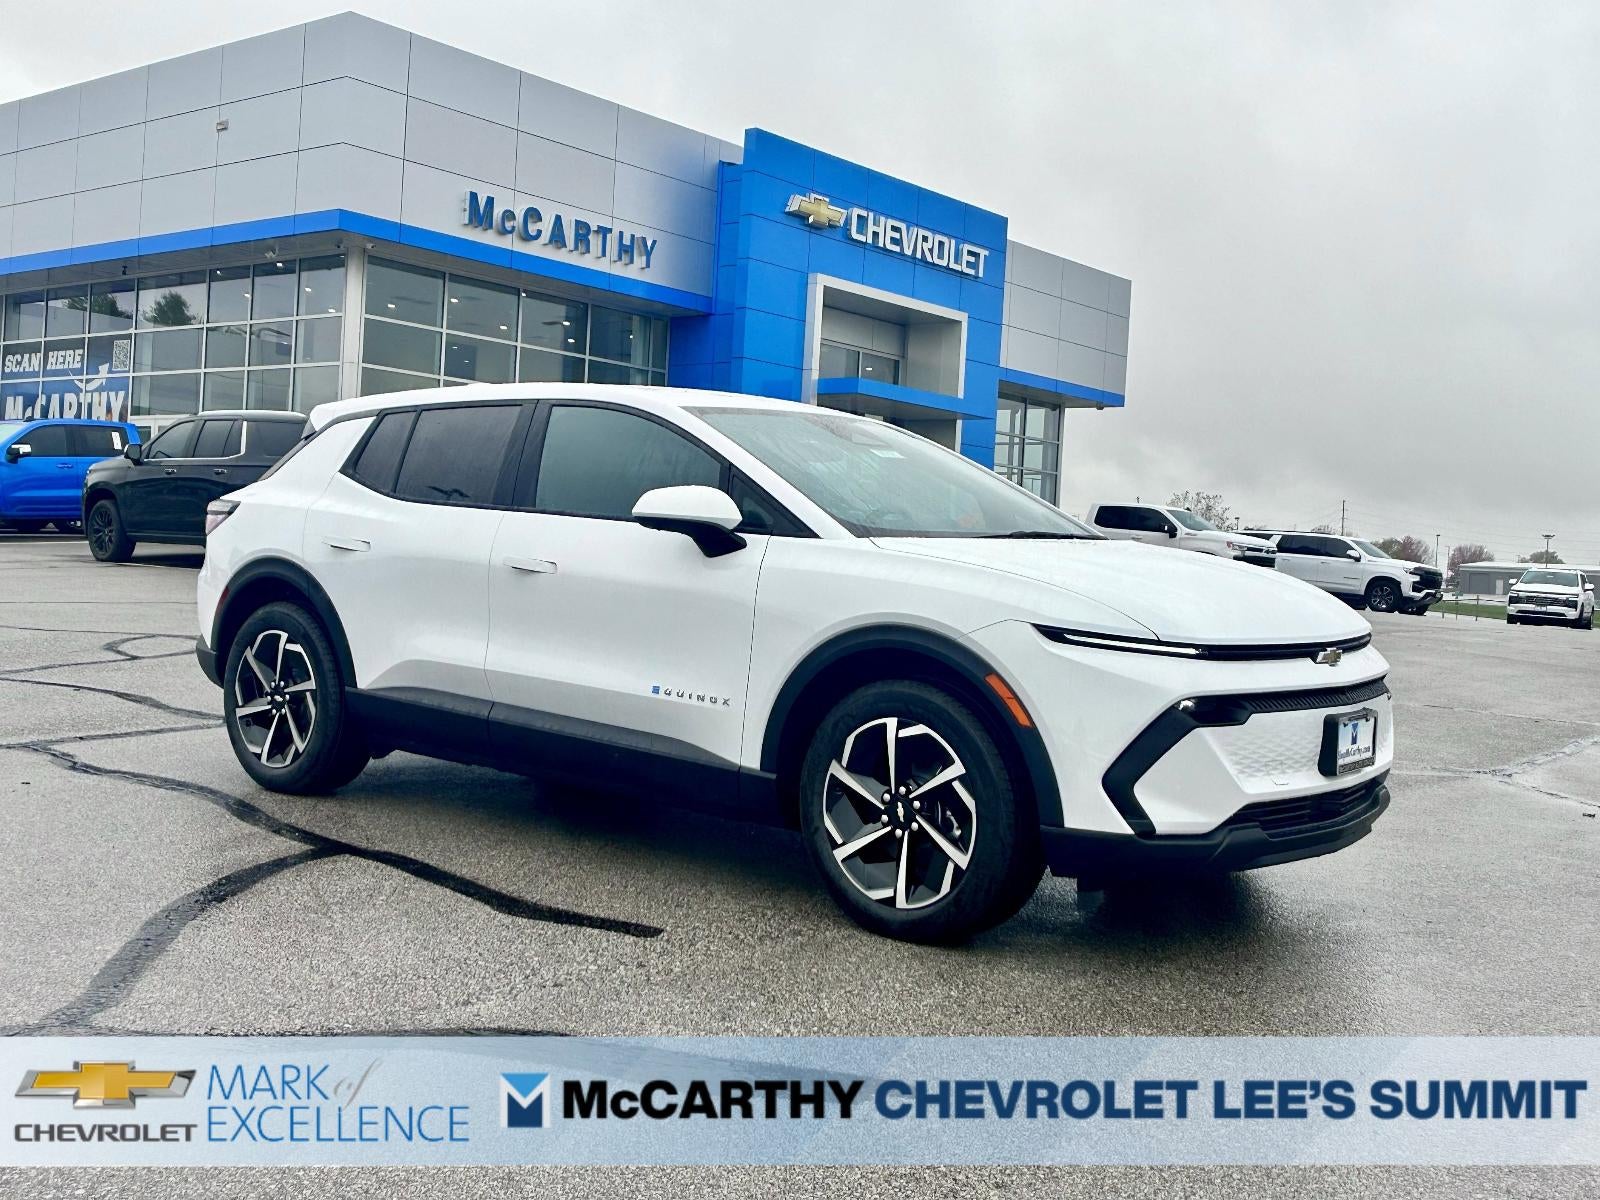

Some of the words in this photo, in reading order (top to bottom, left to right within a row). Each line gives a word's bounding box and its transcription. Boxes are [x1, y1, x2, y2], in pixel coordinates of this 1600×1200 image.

[464, 190, 658, 270] McCARTHY
[848, 207, 990, 279] CHEVROLET
[4, 353, 41, 372] SCAN
[47, 349, 83, 370] HERE
[651, 685, 730, 707] EQUINOX
